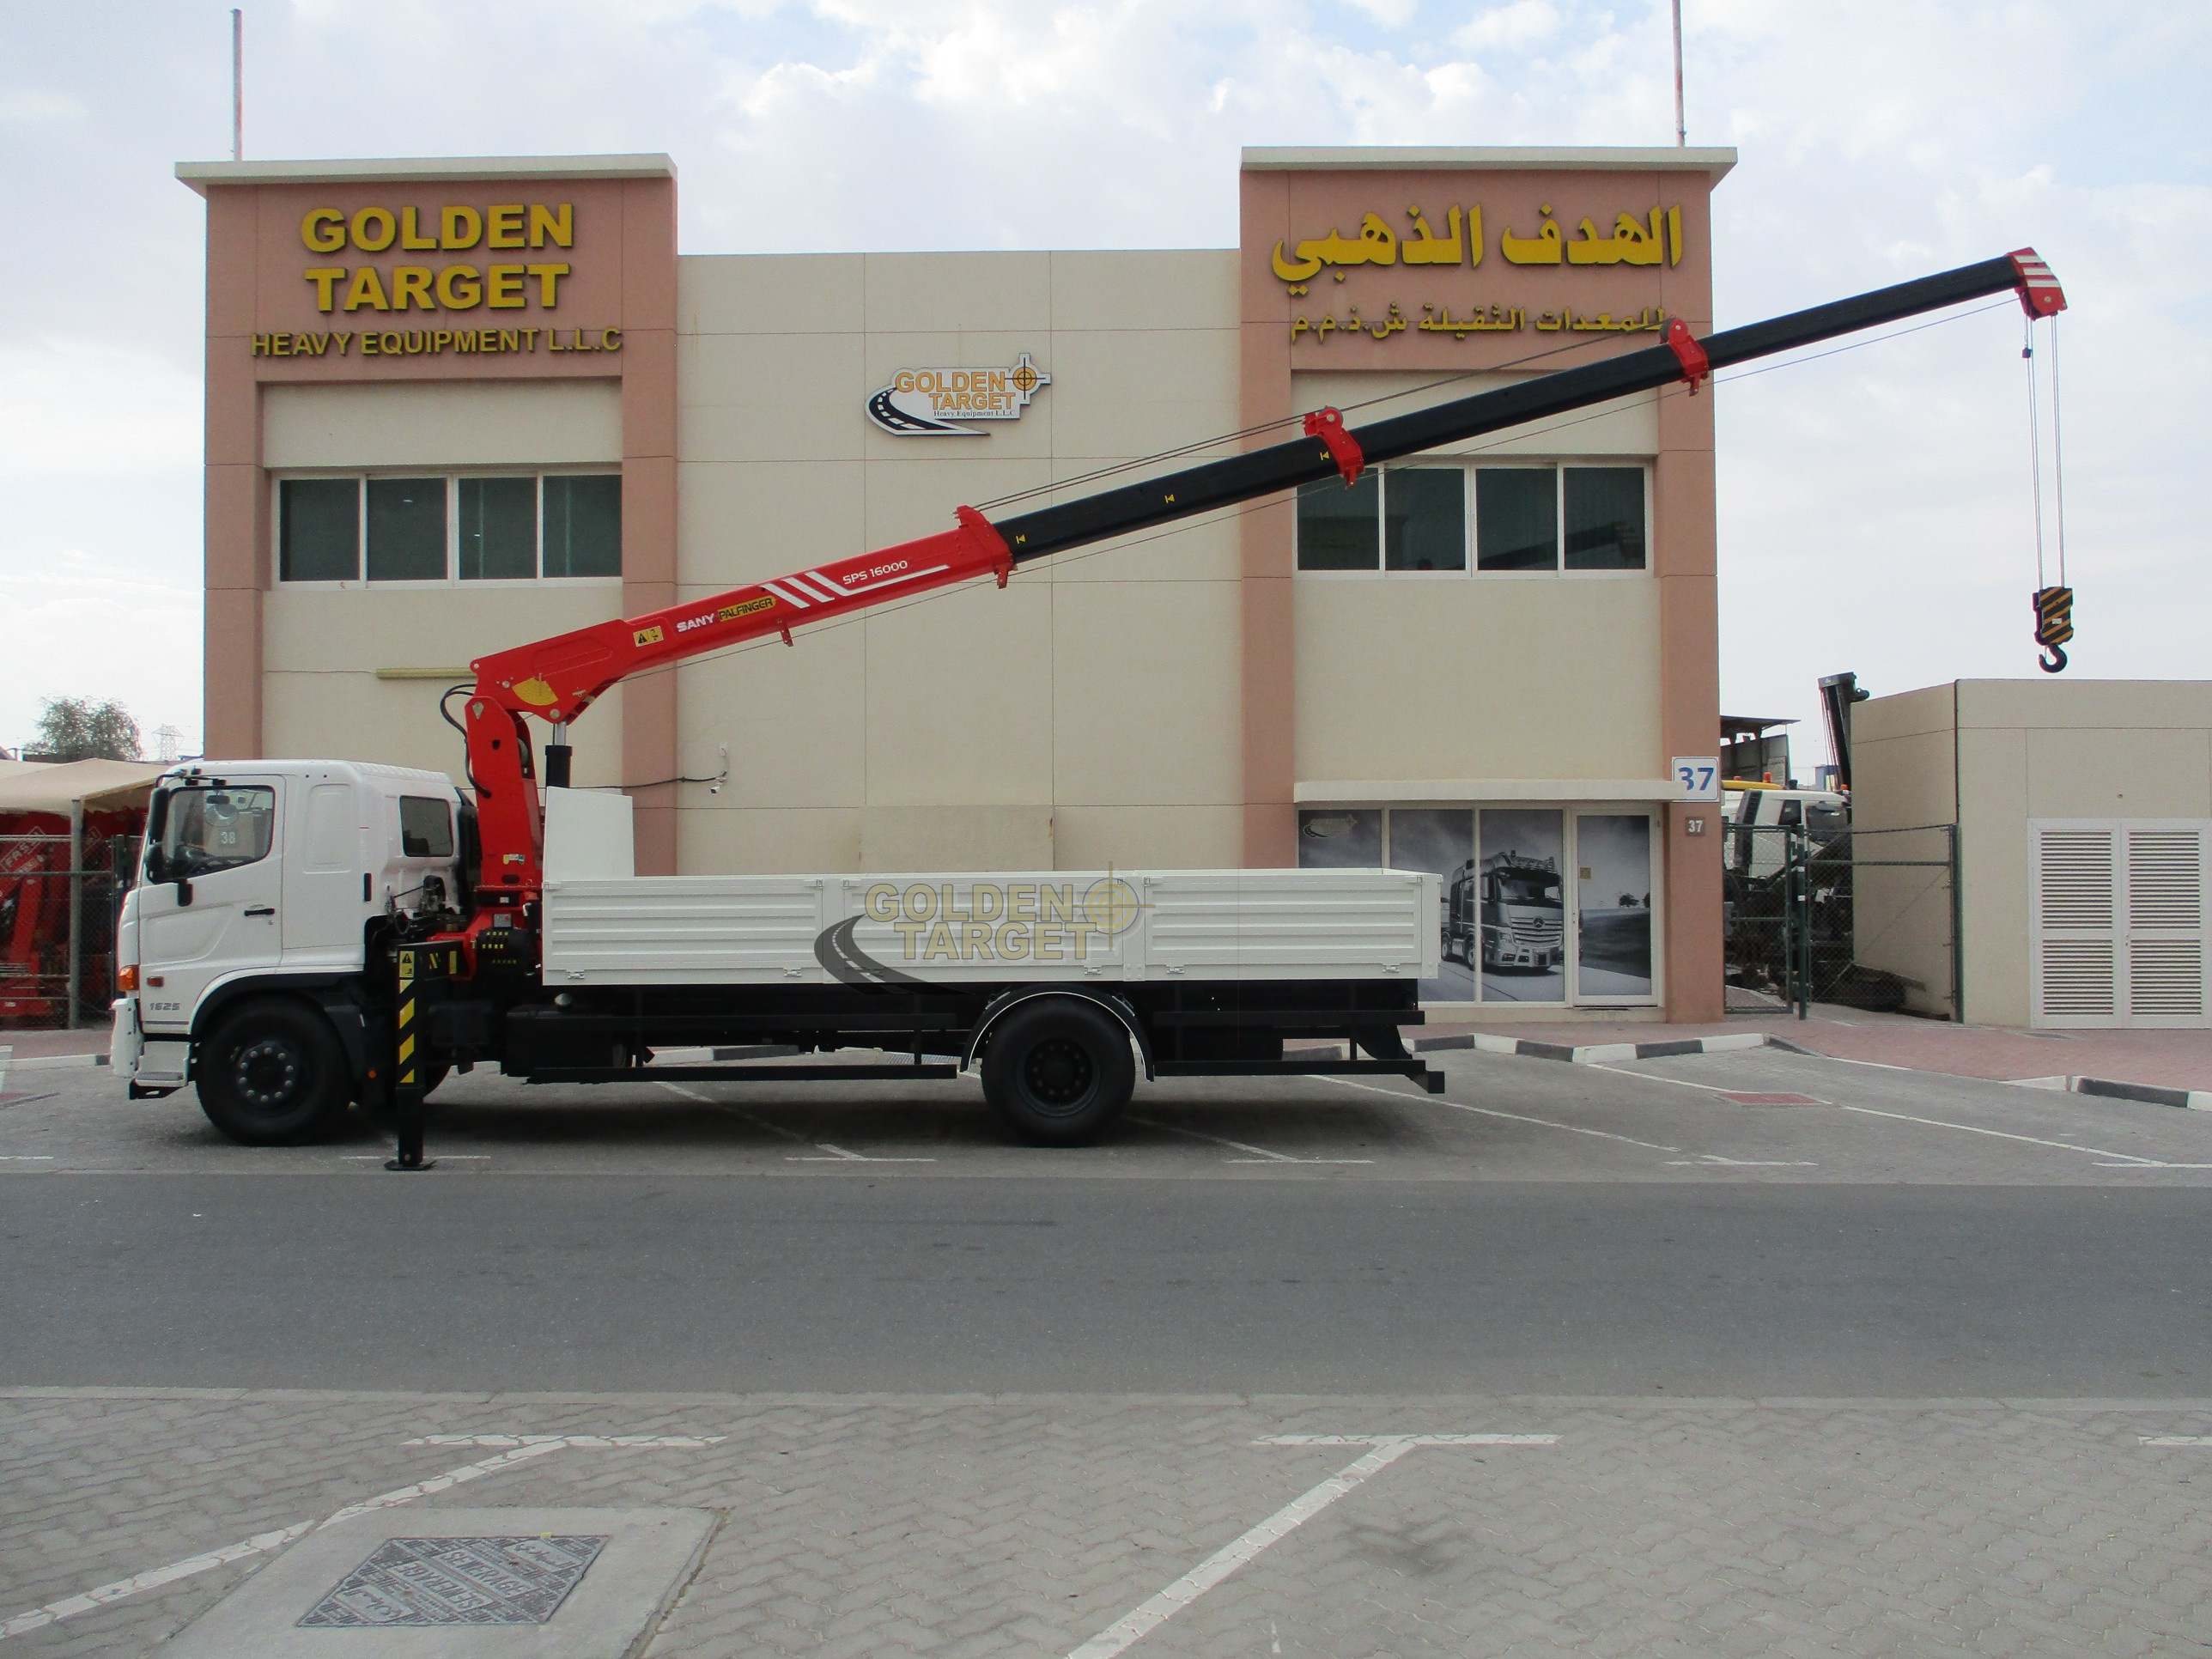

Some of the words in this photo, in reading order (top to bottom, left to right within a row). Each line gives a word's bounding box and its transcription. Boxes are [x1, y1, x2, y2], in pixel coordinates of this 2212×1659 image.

[301, 204, 574, 252] GOLDEN
[1501, 202, 1683, 269] الهدف
[1272, 202, 1484, 296] الذهبي
[305, 263, 569, 313] TARGET
[1419, 302, 1525, 339] الثقيلة
[1535, 305, 1665, 332] للمعدات
[252, 331, 352, 357] HEAVY
[361, 328, 540, 355] EQUIPMENT
[548, 326, 623, 352] L.L.C
[895, 372, 1006, 392] GOLDEN
[929, 392, 1016, 410] TARGET
[842, 571, 868, 586] SPS
[870, 559, 908, 579] 16000
[676, 612, 714, 633] SANY
[718, 597, 774, 622] PALFINGER
[1678, 767, 1714, 791] 37
[1688, 819, 1703, 833] 37
[149, 1002, 180, 1011] 1625
[441, 1551, 530, 1596] SEWERAGE
